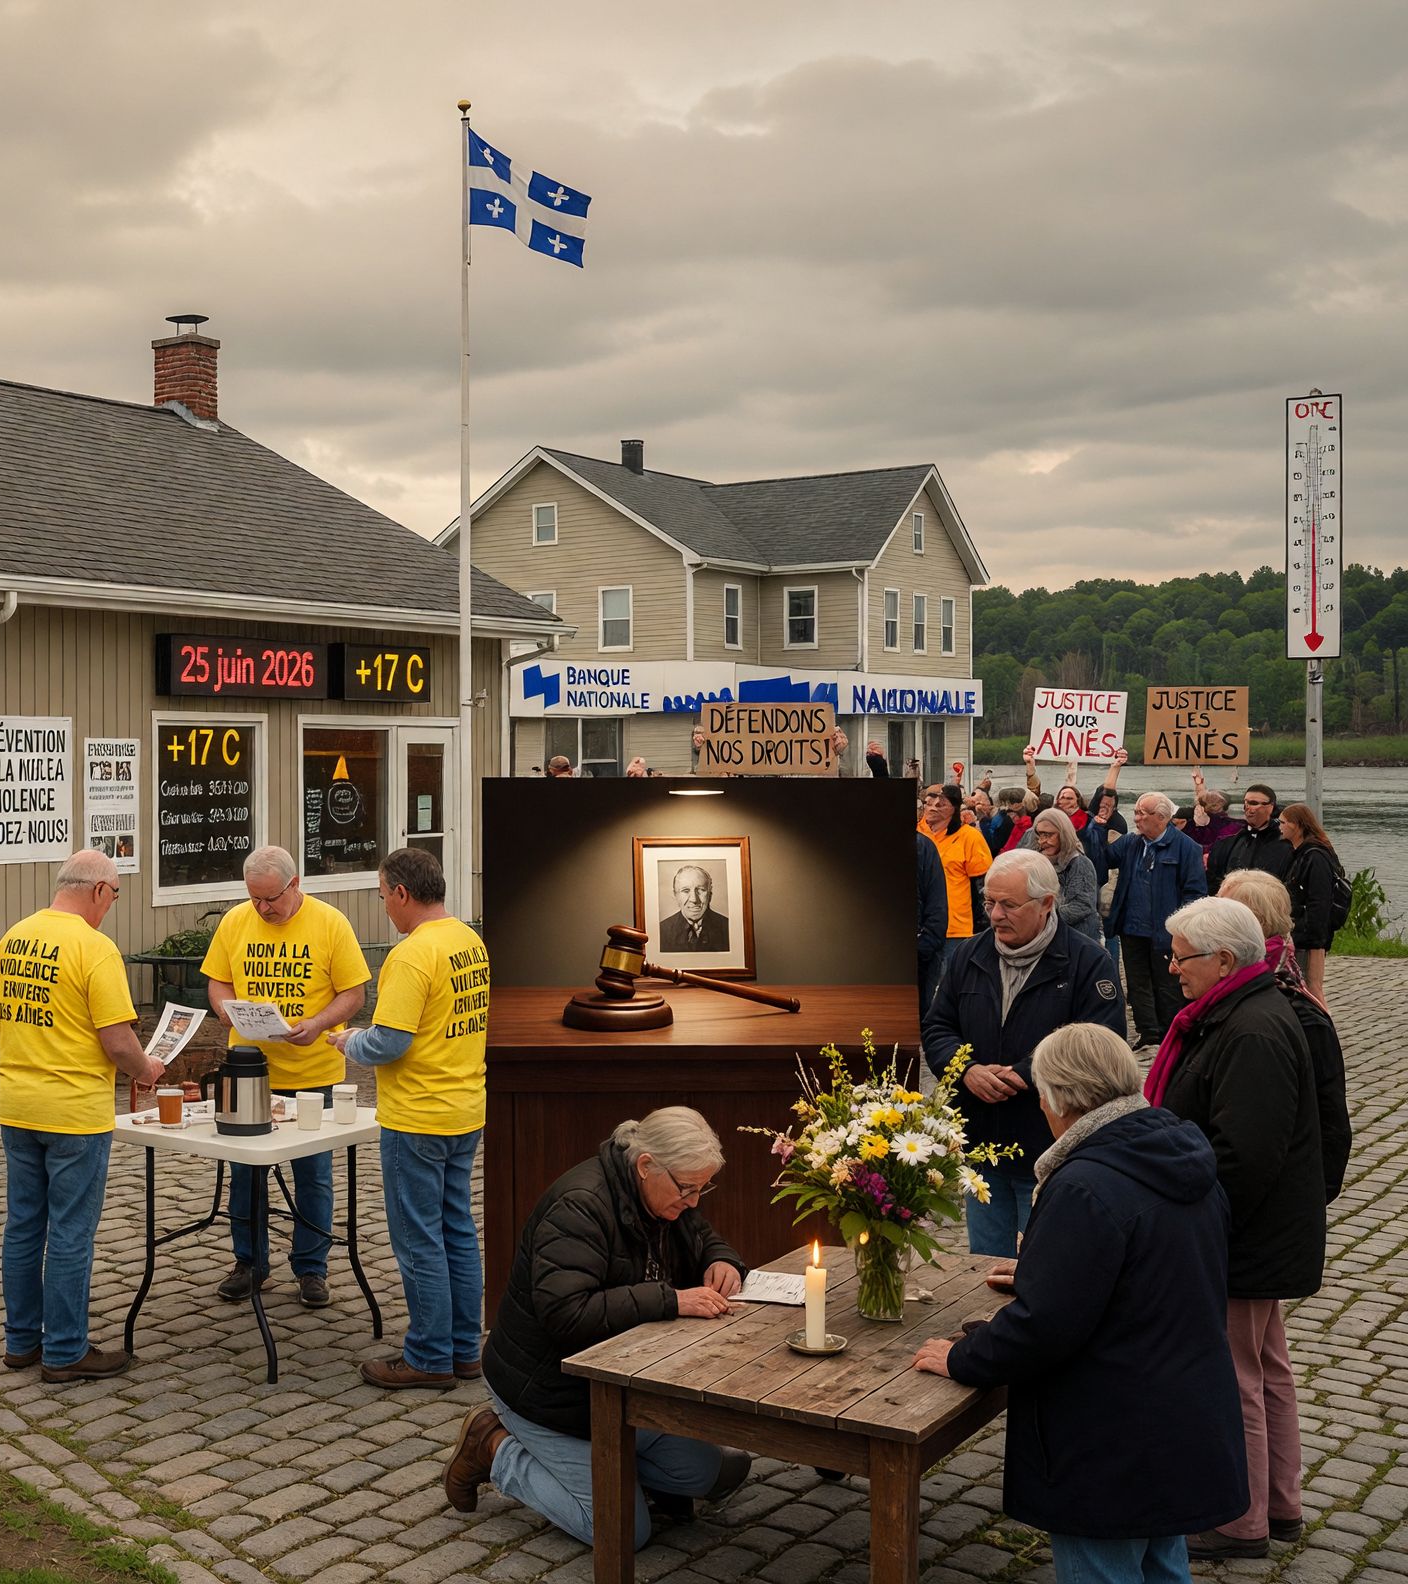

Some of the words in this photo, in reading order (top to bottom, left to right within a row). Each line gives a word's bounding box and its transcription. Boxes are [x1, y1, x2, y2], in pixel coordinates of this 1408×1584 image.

[180, 645, 210, 683] 25
[213, 648, 255, 692] juin
[261, 650, 315, 688] 2026
[355, 653, 400, 692] +17
[406, 654, 424, 693] C
[566, 666, 631, 688] BANQUE
[566, 690, 650, 710] NATIONALE
[1036, 691, 1122, 714] JUSTICE
[1152, 689, 1237, 712] JUSTICE
[709, 703, 827, 734] DÉFENDONS
[1175, 712, 1211, 729] LES
[167, 728, 214, 766] +17
[222, 728, 240, 766] C
[706, 738, 744, 766] NOS
[751, 738, 831, 770] DROITS!
[40, 942, 60, 962] LA
[246, 943, 275, 958] NON
[292, 943, 311, 959] LA
[243, 961, 313, 979] VIOLENCE
[247, 981, 306, 998] ENVERS
